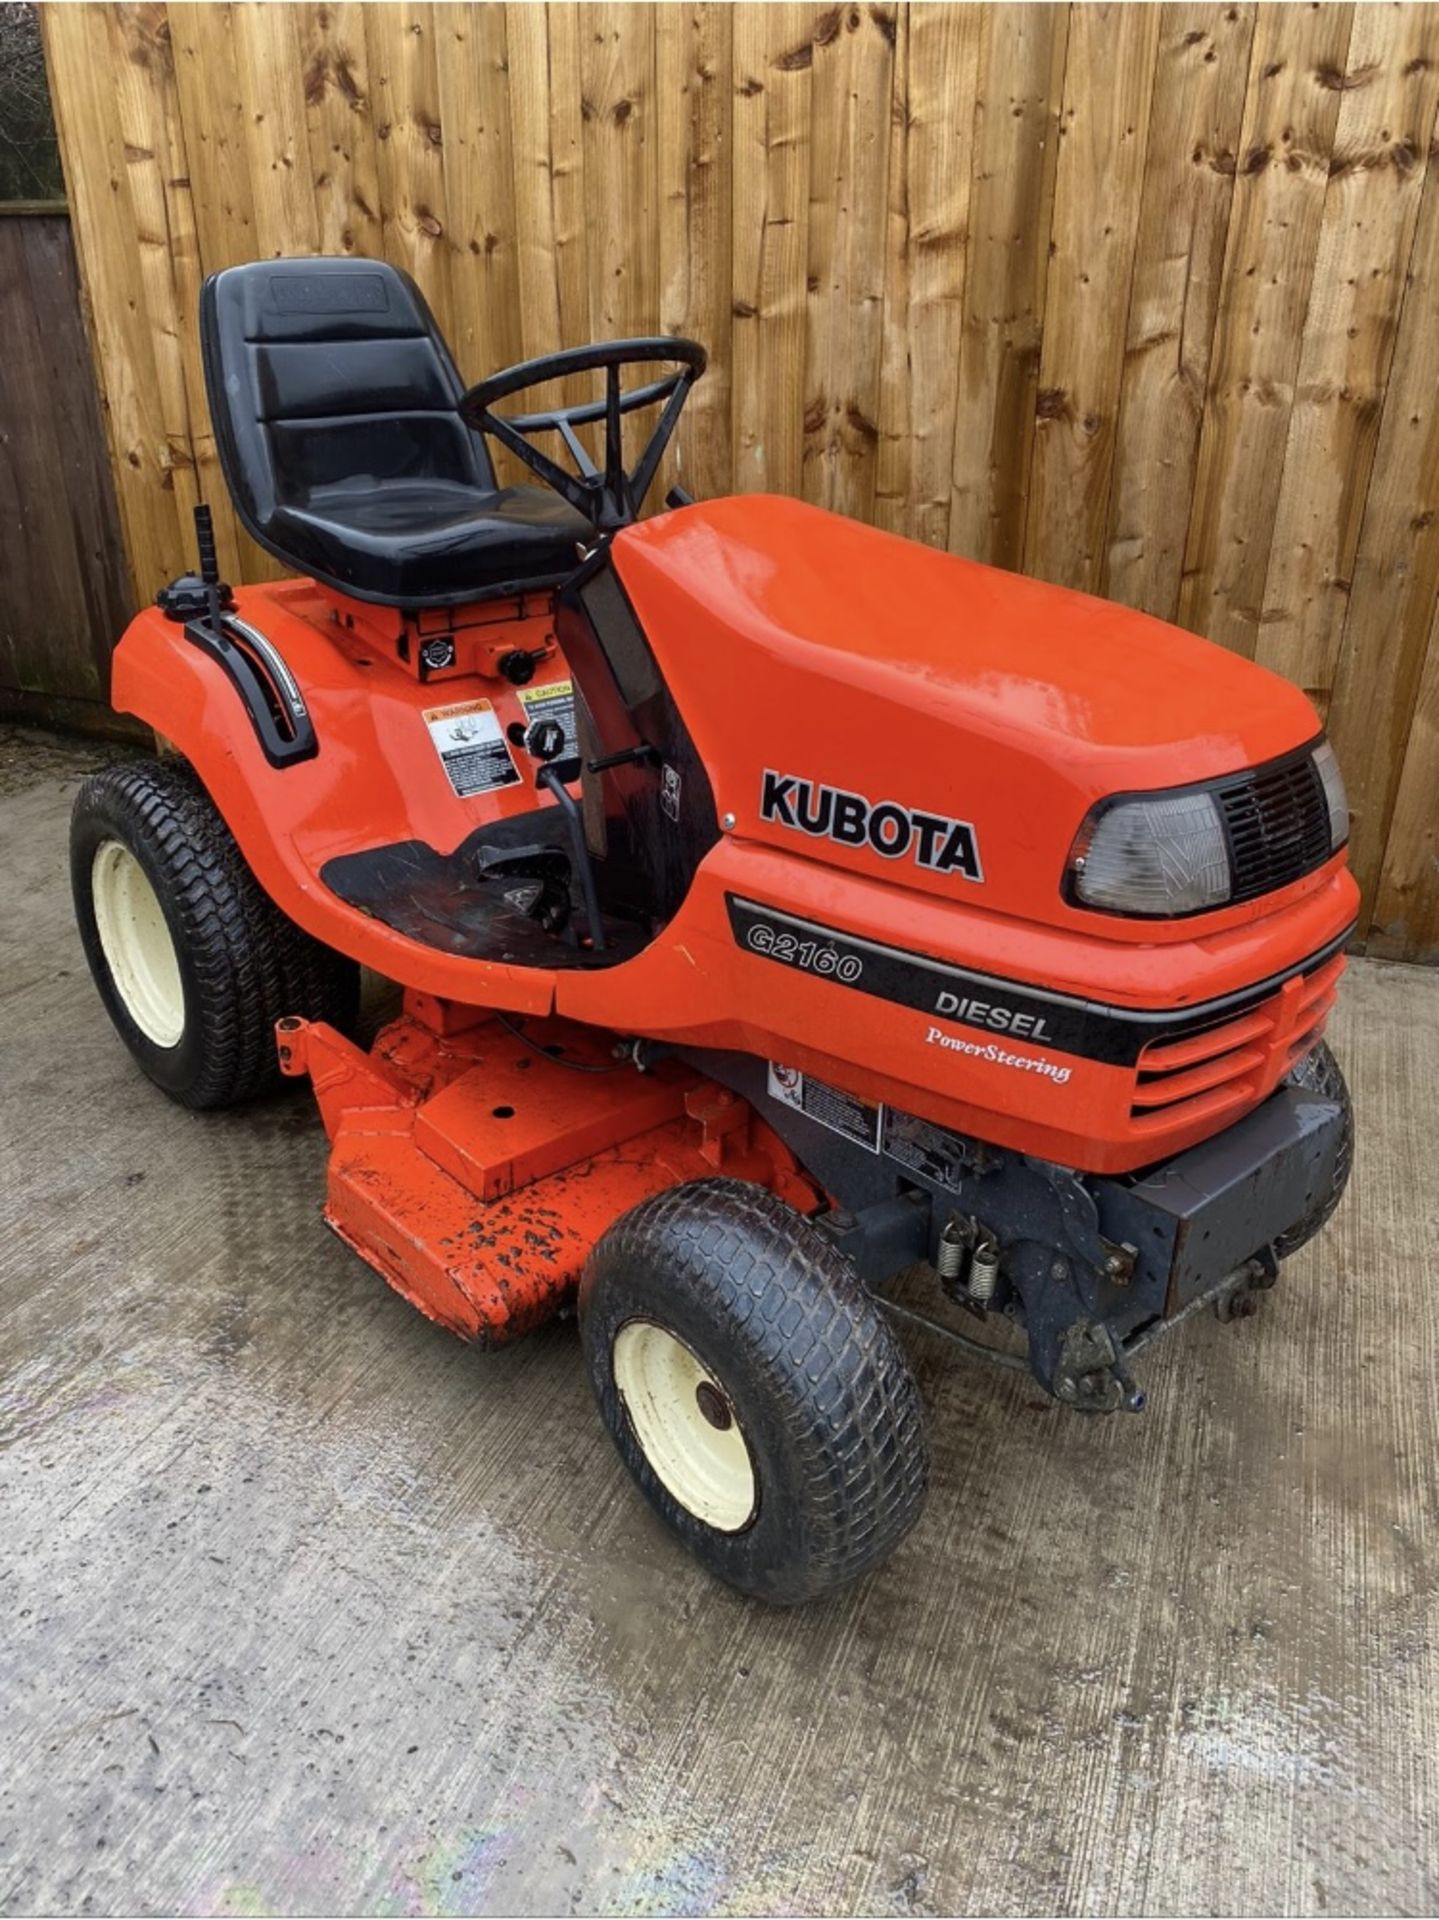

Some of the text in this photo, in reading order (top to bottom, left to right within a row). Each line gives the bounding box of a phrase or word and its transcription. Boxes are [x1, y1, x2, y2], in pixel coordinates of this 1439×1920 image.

[760, 768, 984, 883] KUBOTA
[747, 924, 862, 982] G2160
[934, 991, 1053, 1042] DIESEL
[925, 1026, 1073, 1083] PowerSteering
